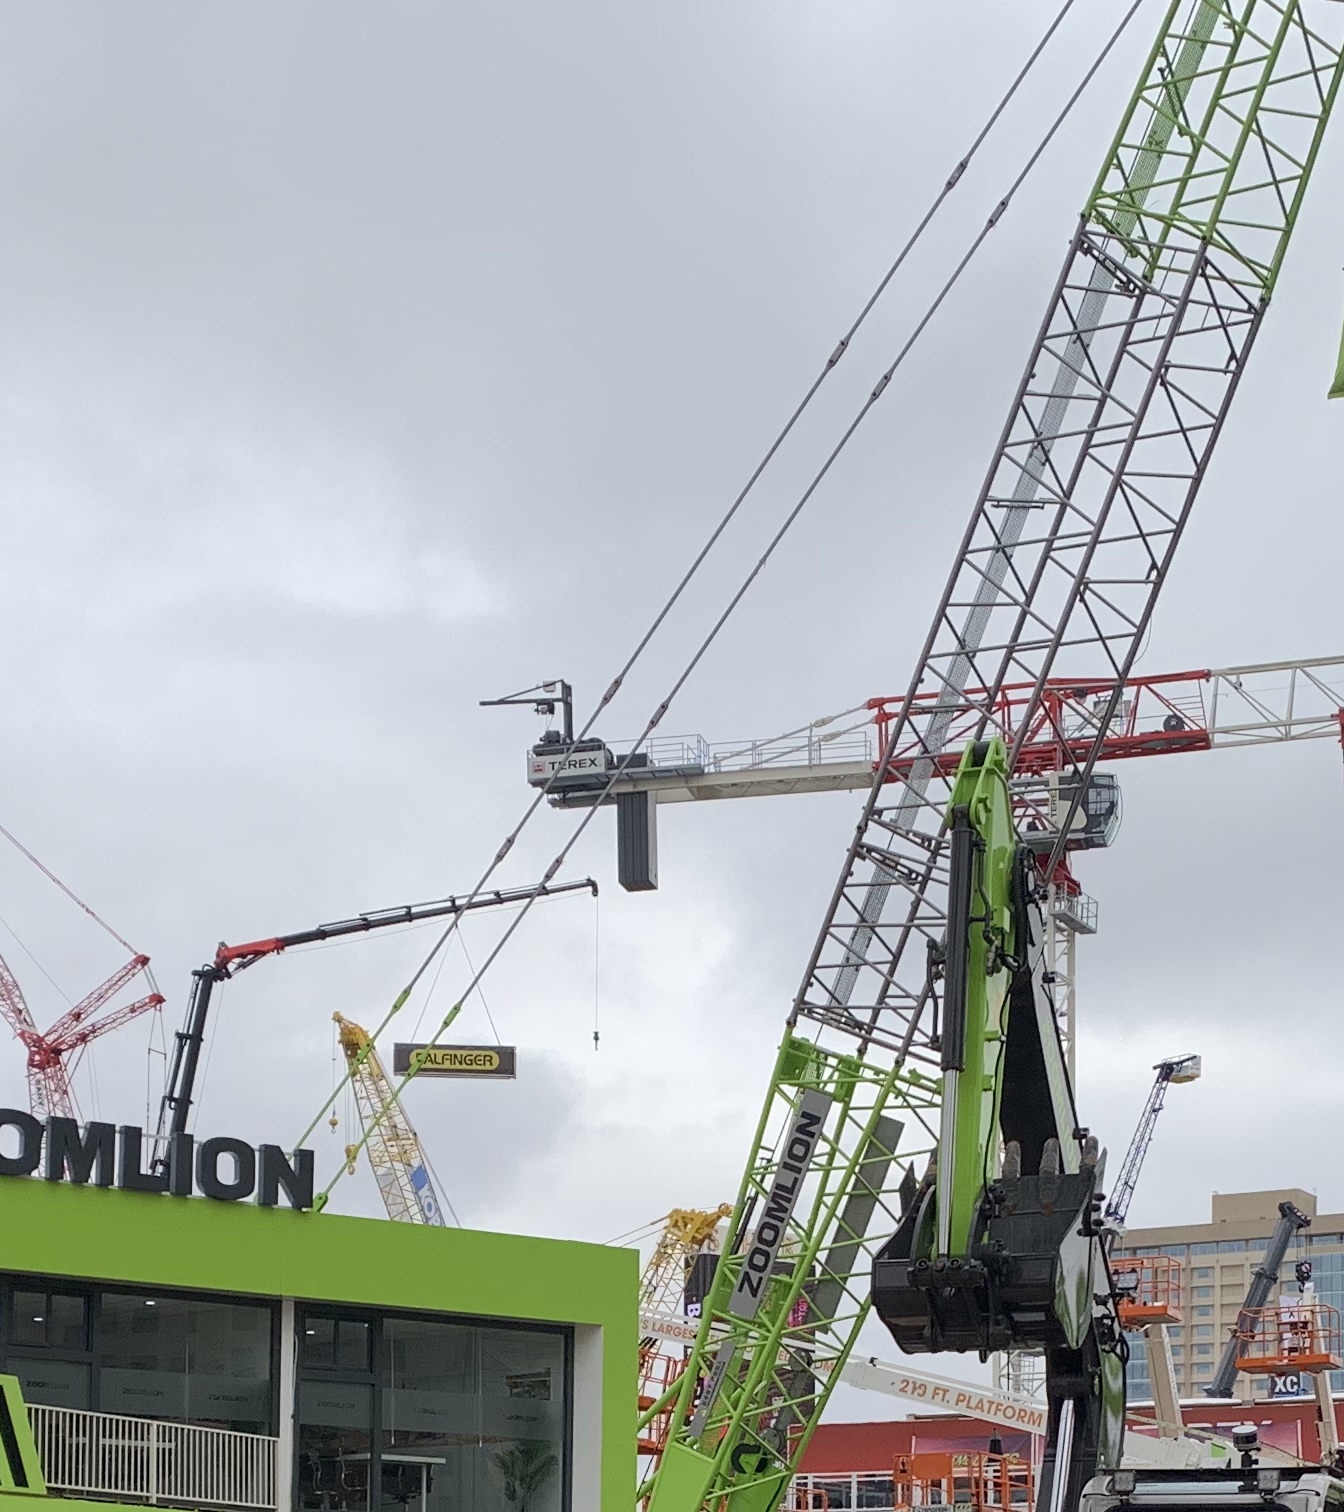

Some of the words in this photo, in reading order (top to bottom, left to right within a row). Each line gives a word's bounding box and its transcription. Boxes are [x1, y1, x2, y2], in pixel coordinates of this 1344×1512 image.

[1050, 790, 1058, 818] TERE
[737, 1110, 822, 1299] ZOOMLION
[651, 1322, 697, 1340] LARGES
[955, 1392, 1044, 1428] PLATFORM
